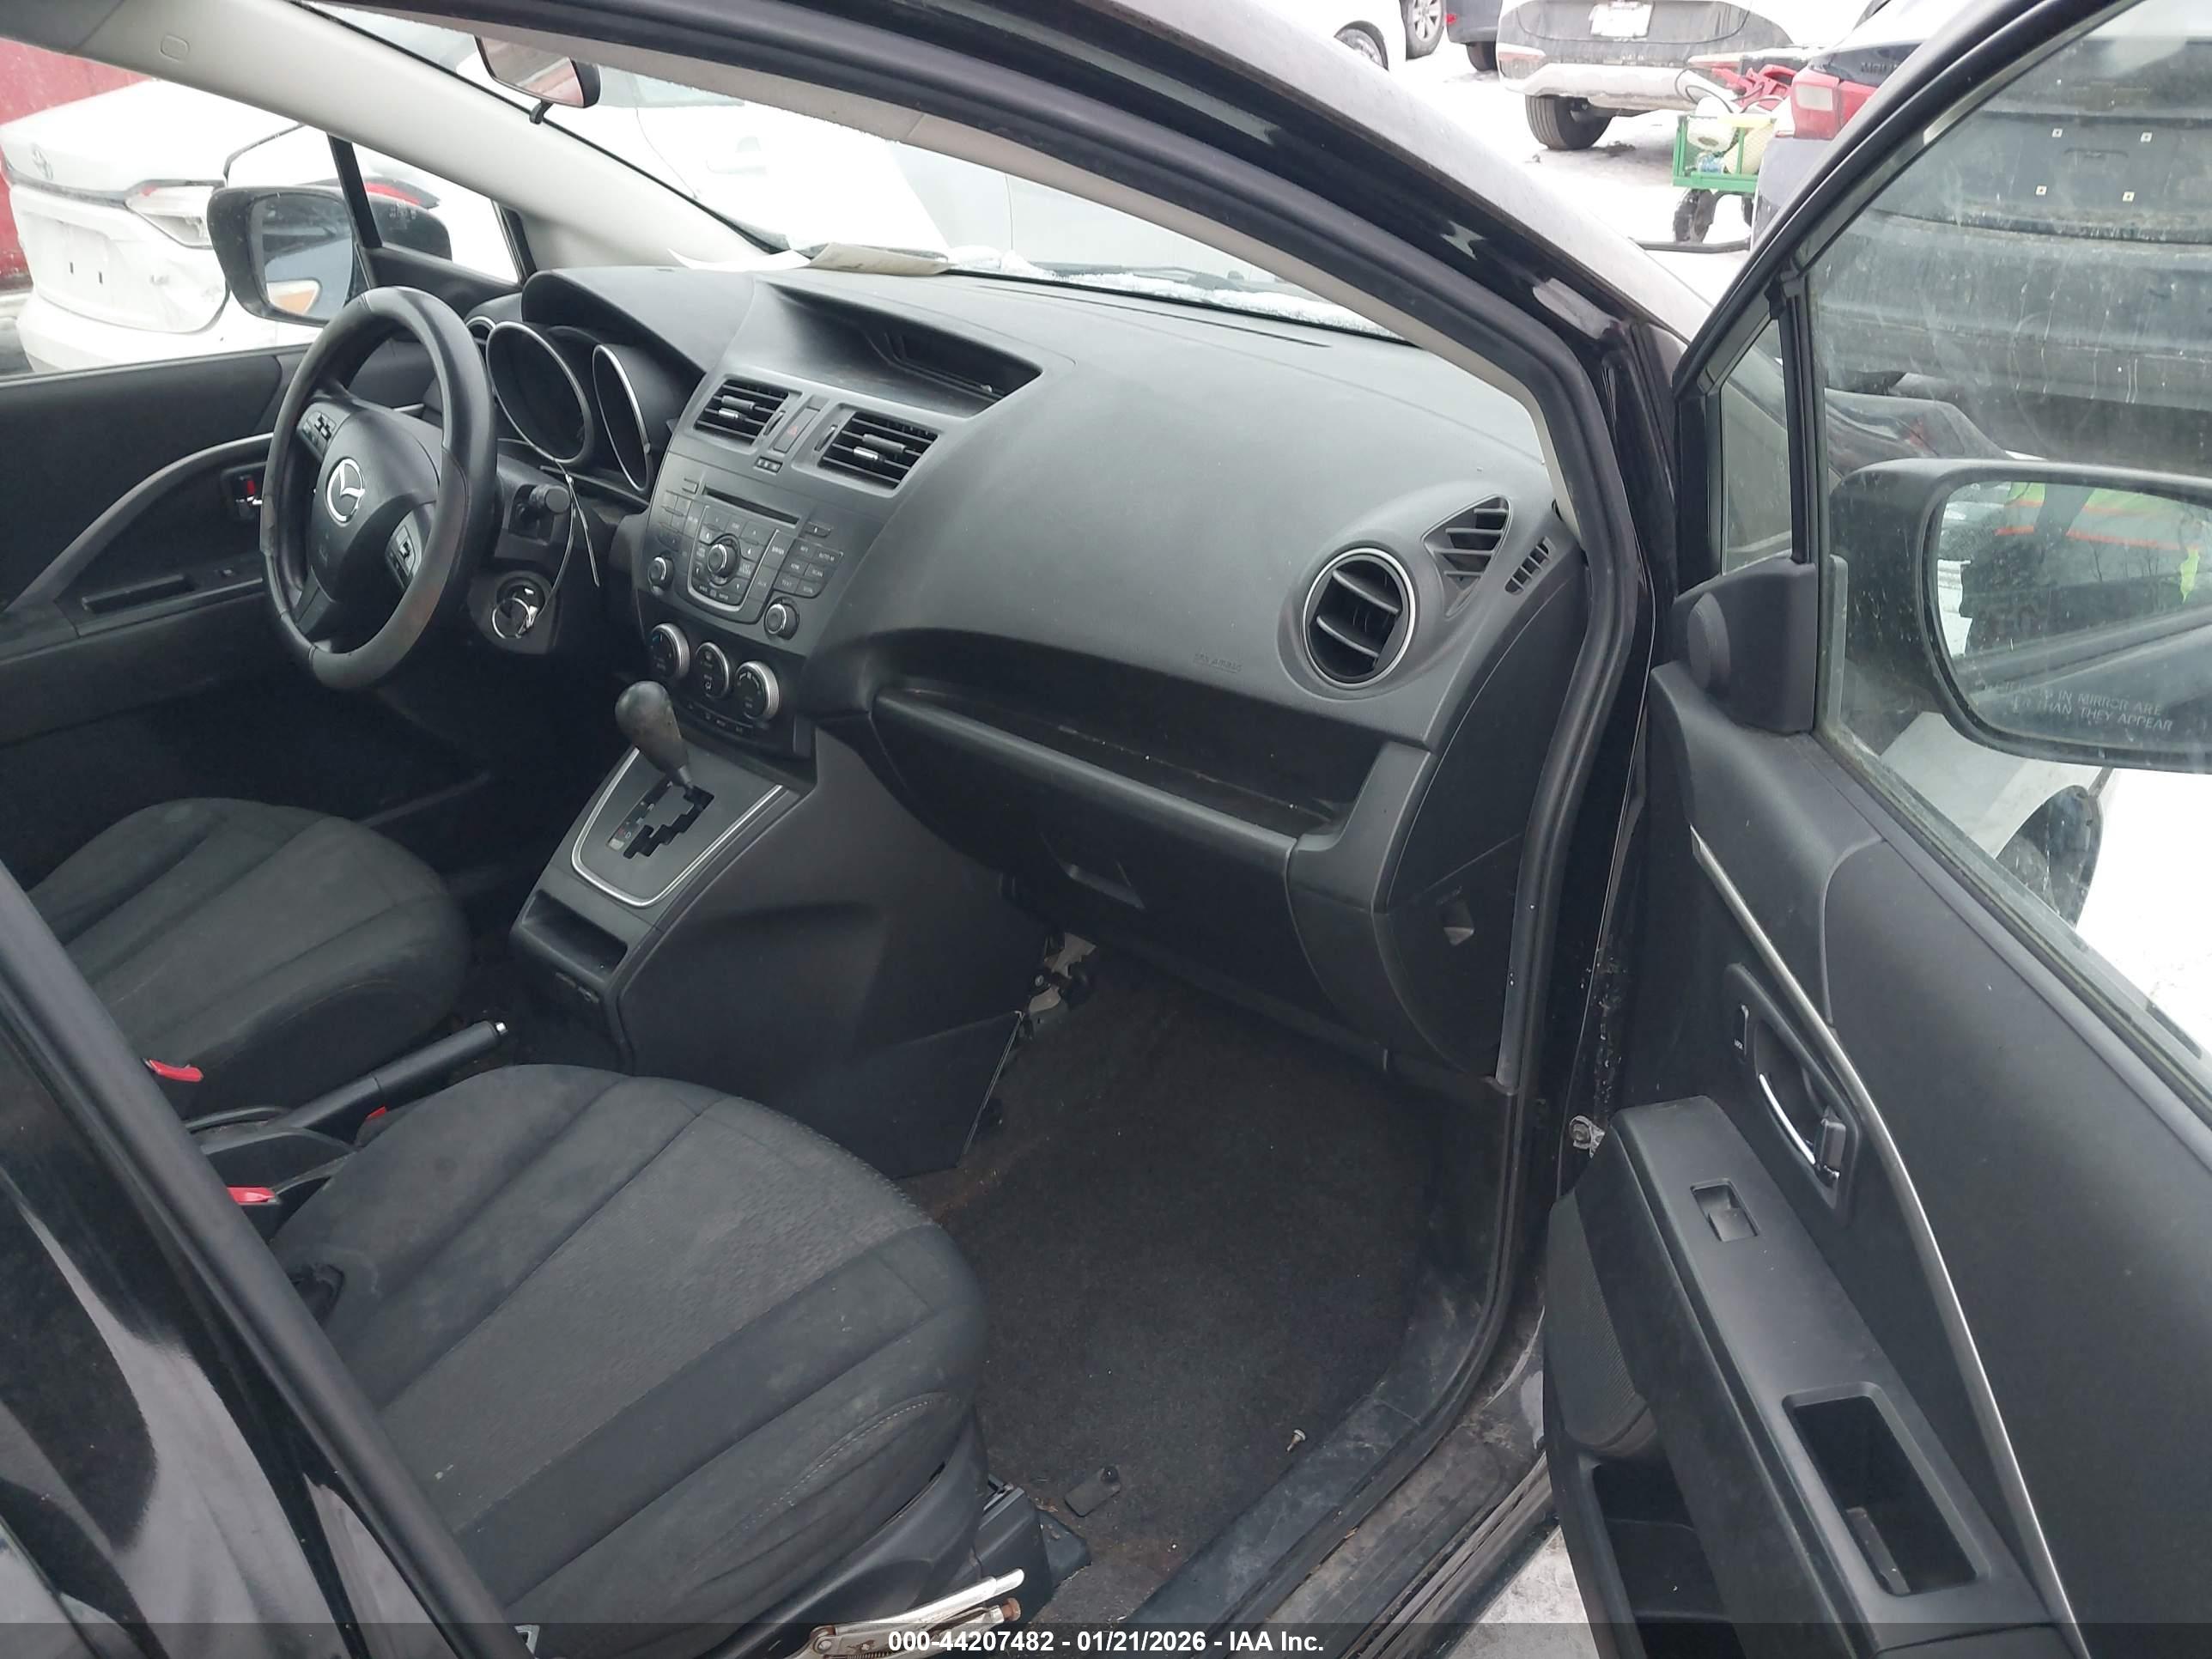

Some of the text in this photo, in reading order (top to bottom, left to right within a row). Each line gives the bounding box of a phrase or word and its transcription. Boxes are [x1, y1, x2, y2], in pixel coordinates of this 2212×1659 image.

[2078, 693, 2129, 711] MIRROR
[2133, 701, 2163, 716] ARE
[2081, 707, 2113, 721] THEY
[2117, 714, 2173, 732] APPEAR
